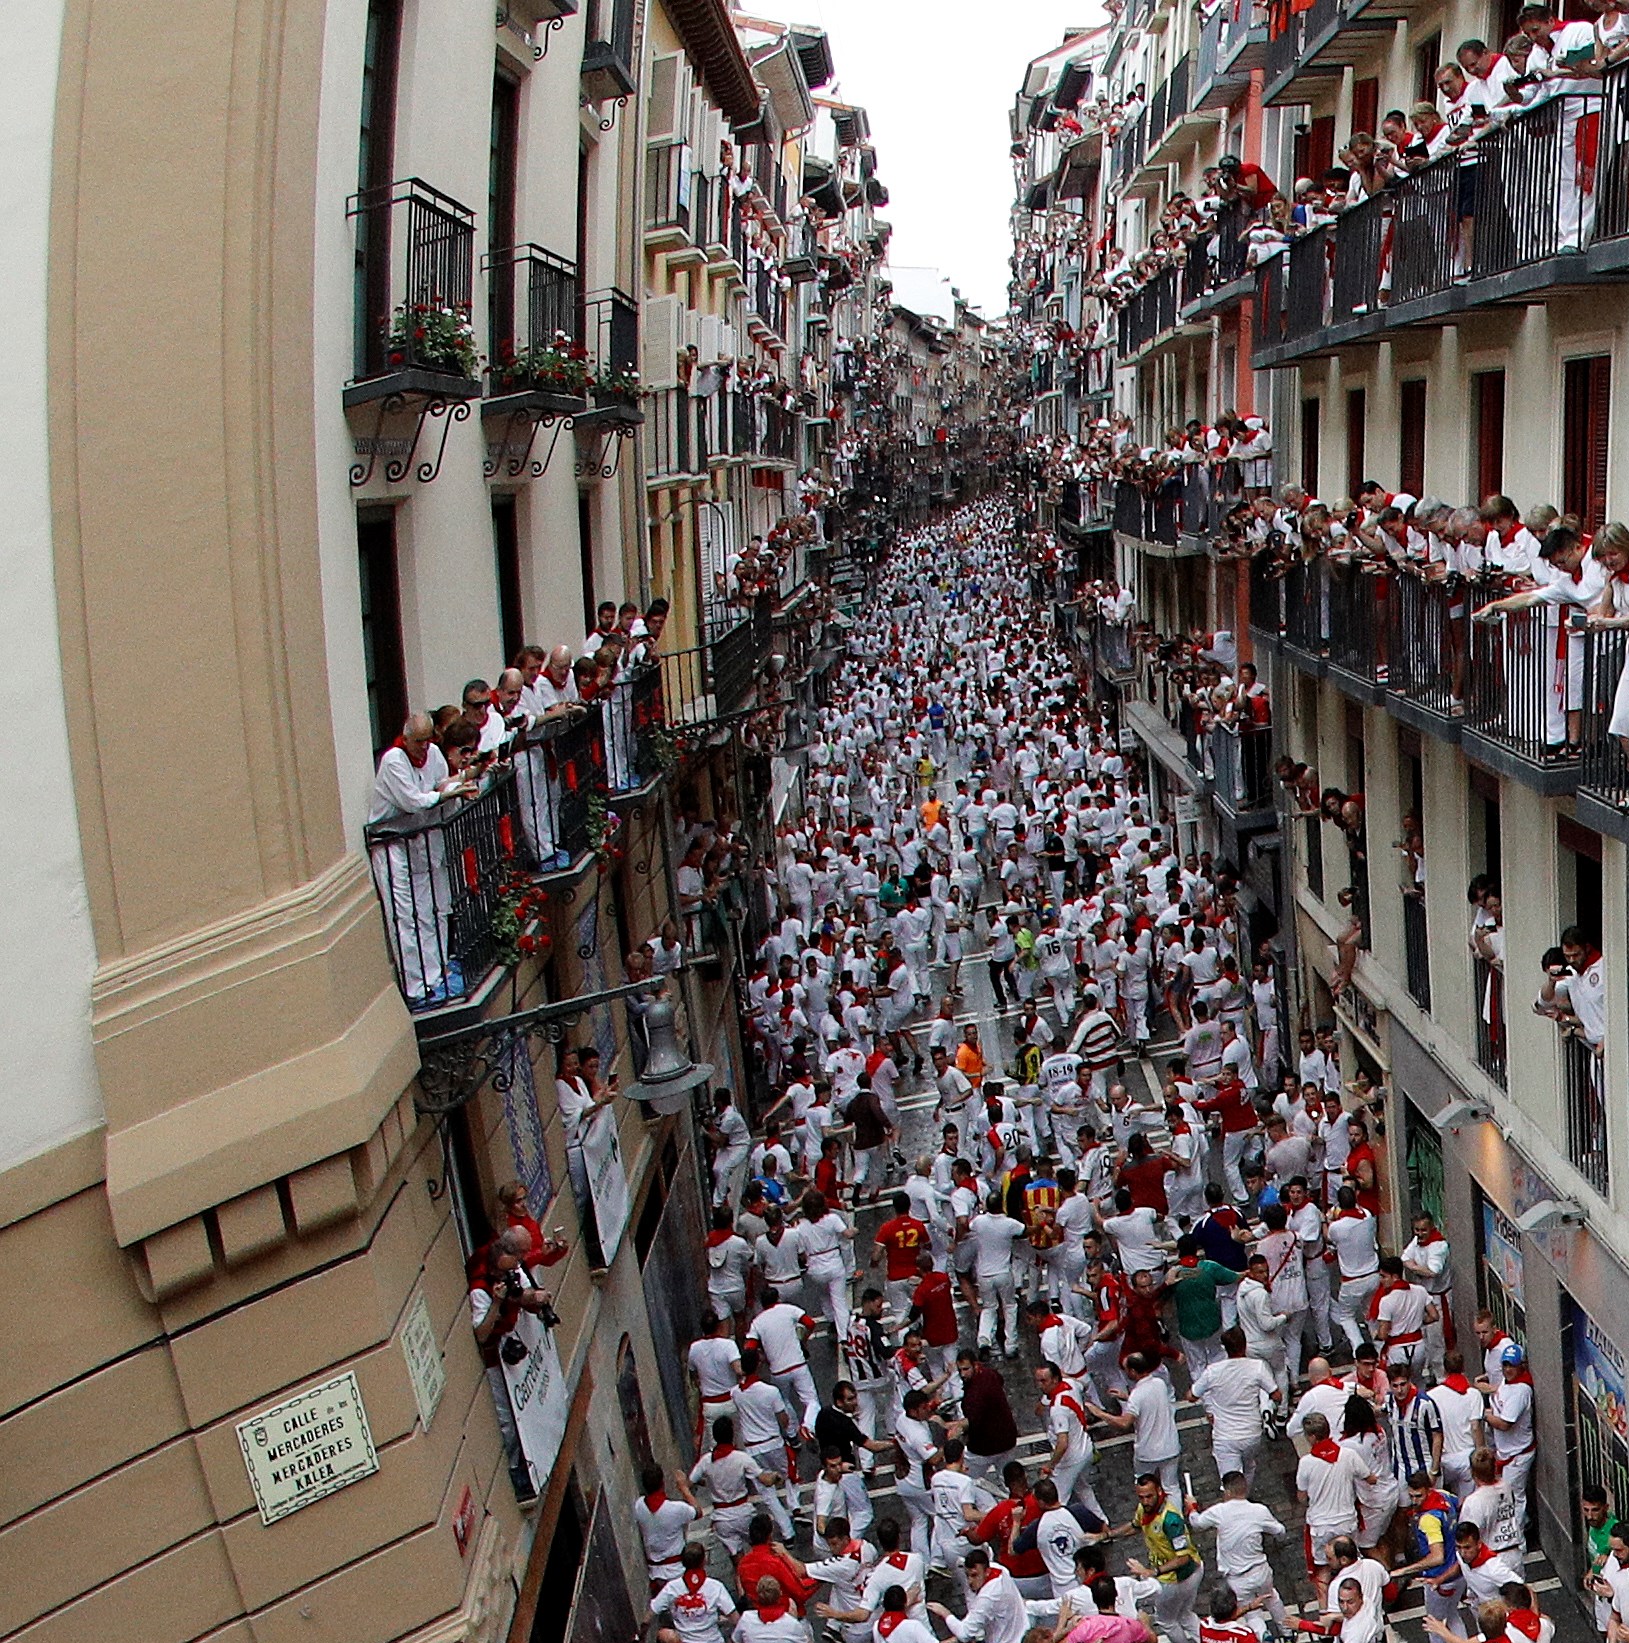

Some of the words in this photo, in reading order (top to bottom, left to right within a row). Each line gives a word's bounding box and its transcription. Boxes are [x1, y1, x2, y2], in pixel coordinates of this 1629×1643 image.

[1045, 940, 1061, 956] 16
[1048, 1063, 1073, 1079] 18-19
[1003, 1128, 1021, 1150] 20
[895, 1228, 919, 1248] 12
[283, 1407, 319, 1434] CALLE
[267, 1416, 344, 1462] MERCADERES
[272, 1437, 353, 1485] MERCADERES
[295, 1463, 335, 1491] KALEA
